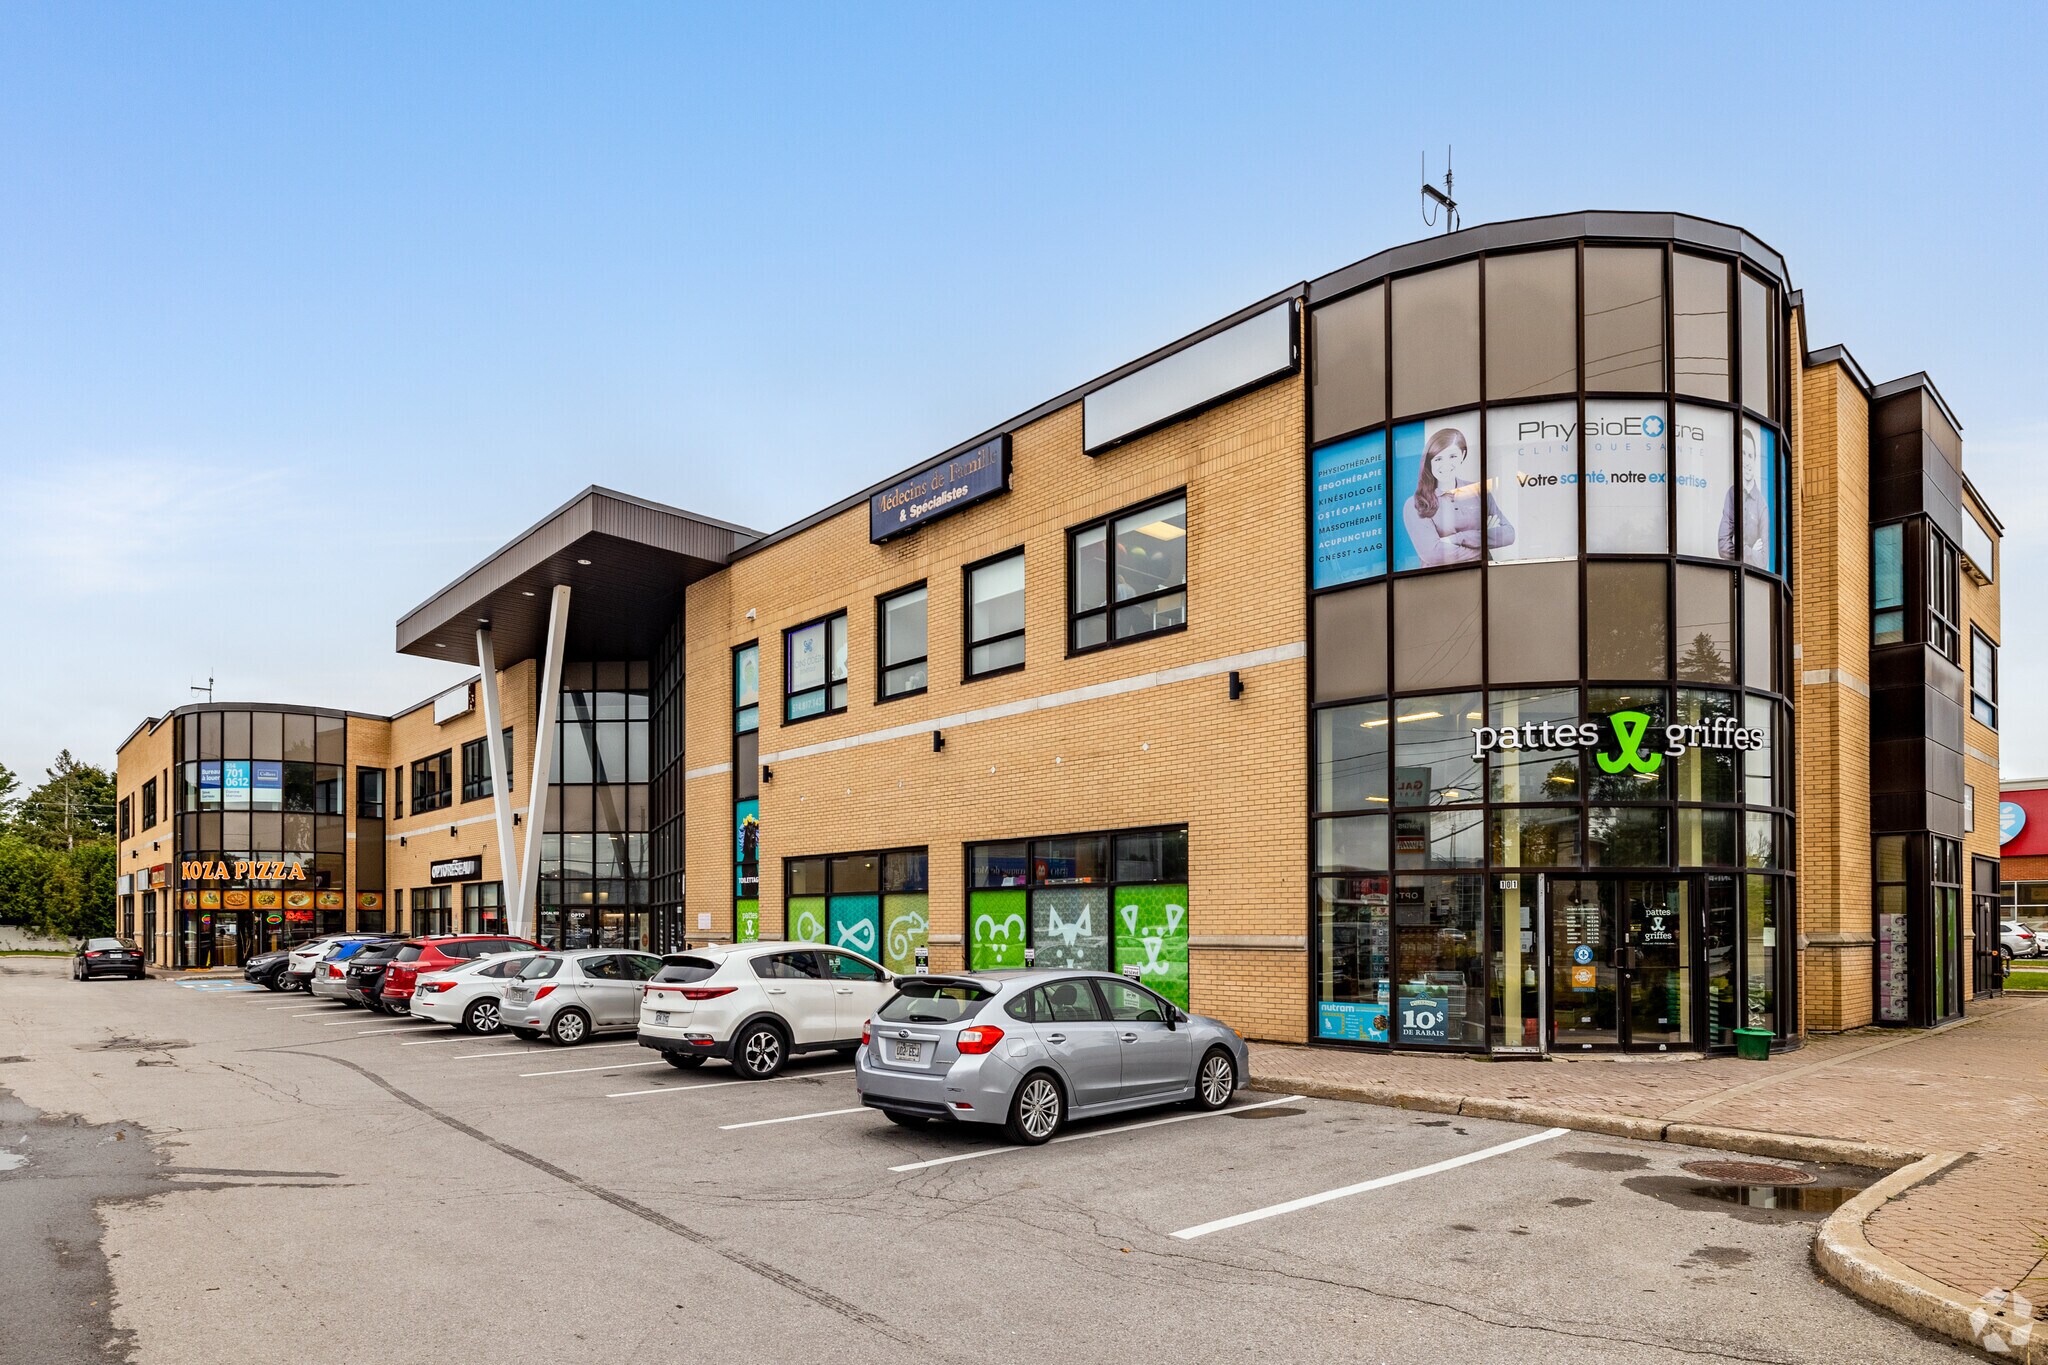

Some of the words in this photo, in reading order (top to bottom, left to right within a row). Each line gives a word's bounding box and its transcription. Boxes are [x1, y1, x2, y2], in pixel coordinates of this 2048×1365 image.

[1518, 443, 1631, 456] CLINQUE
[1318, 454, 1382, 477] PHYSIOTHÉRAPIE
[1318, 469, 1382, 492] ERGOTHÉRAPIE
[1517, 471, 1558, 488] Votre
[1611, 470, 1647, 483] notre
[1648, 473, 1707, 488] exertise
[875, 482, 927, 515] Médecins
[931, 470, 945, 490] de
[1318, 484, 1382, 506] KINÉSIOLOGIE
[899, 509, 907, 523] &
[909, 485, 968, 518] Spécialistes
[1318, 498, 1383, 521] OSTÉOPATHIE
[1318, 513, 1382, 535] MASSOTHÉRAPIE
[1318, 528, 1382, 549] ACUPUNCTURE
[1318, 550, 1351, 563] CNESST
[1357, 542, 1383, 554] SAAQ
[1471, 720, 1599, 759] pattes
[1665, 717, 1764, 756] griffes
[226, 769, 243, 777] 701
[226, 778, 249, 787] 0612
[182, 861, 230, 881] KOZA
[234, 861, 306, 881] PIZZA
[1500, 881, 1518, 889] 101
[1645, 908, 1671, 918] pattes
[1644, 931, 1672, 942] griffes
[1321, 1003, 1355, 1013] nutram
[1415, 1029, 1445, 1037] RABAIS
